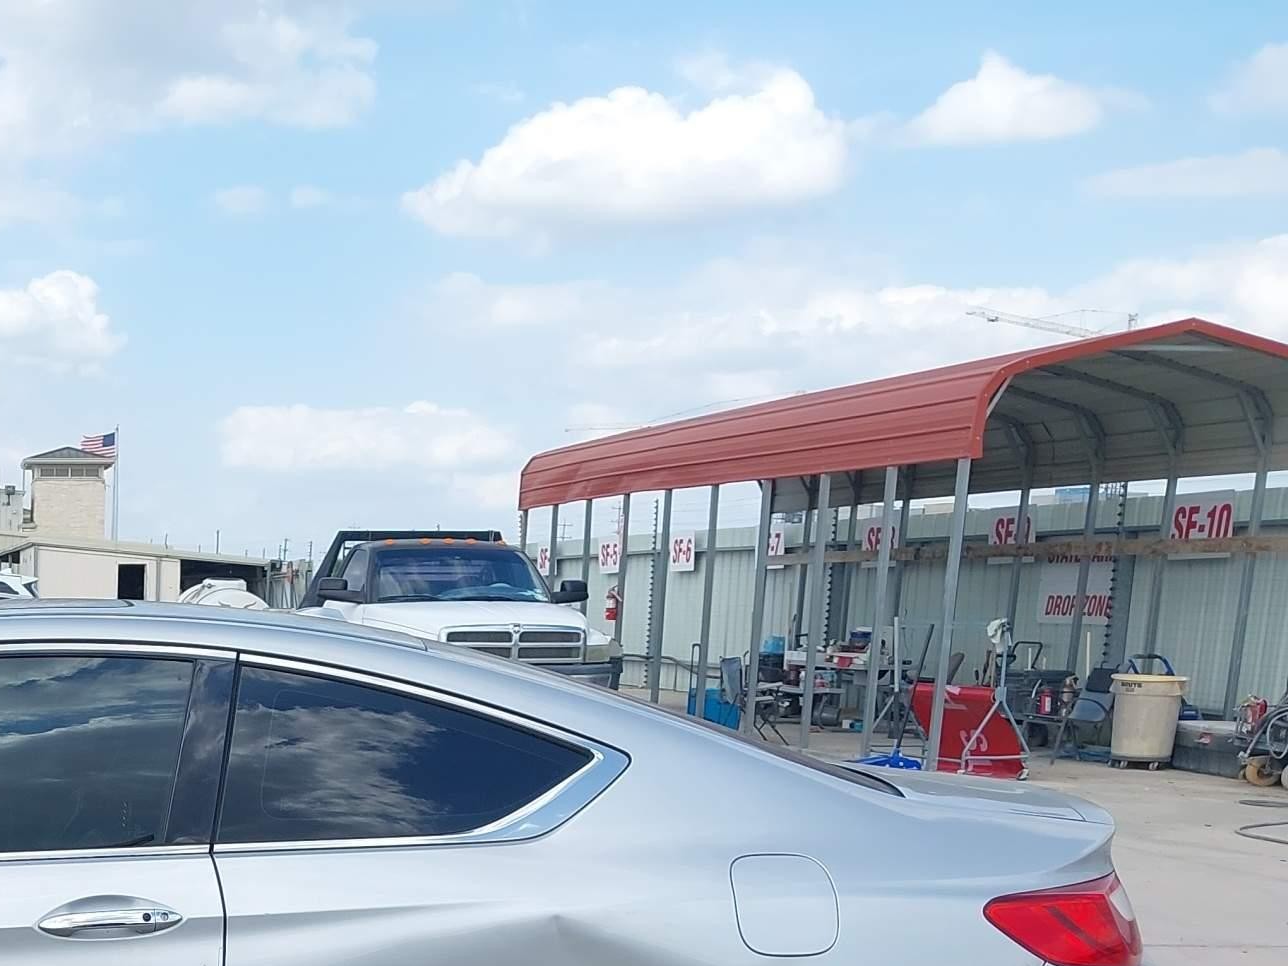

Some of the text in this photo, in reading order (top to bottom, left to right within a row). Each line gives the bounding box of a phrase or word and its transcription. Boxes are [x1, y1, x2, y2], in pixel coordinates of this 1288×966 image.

[1171, 503, 1232, 540] SF-10
[601, 543, 618, 567] SF-5
[672, 538, 692, 564] SF-6
